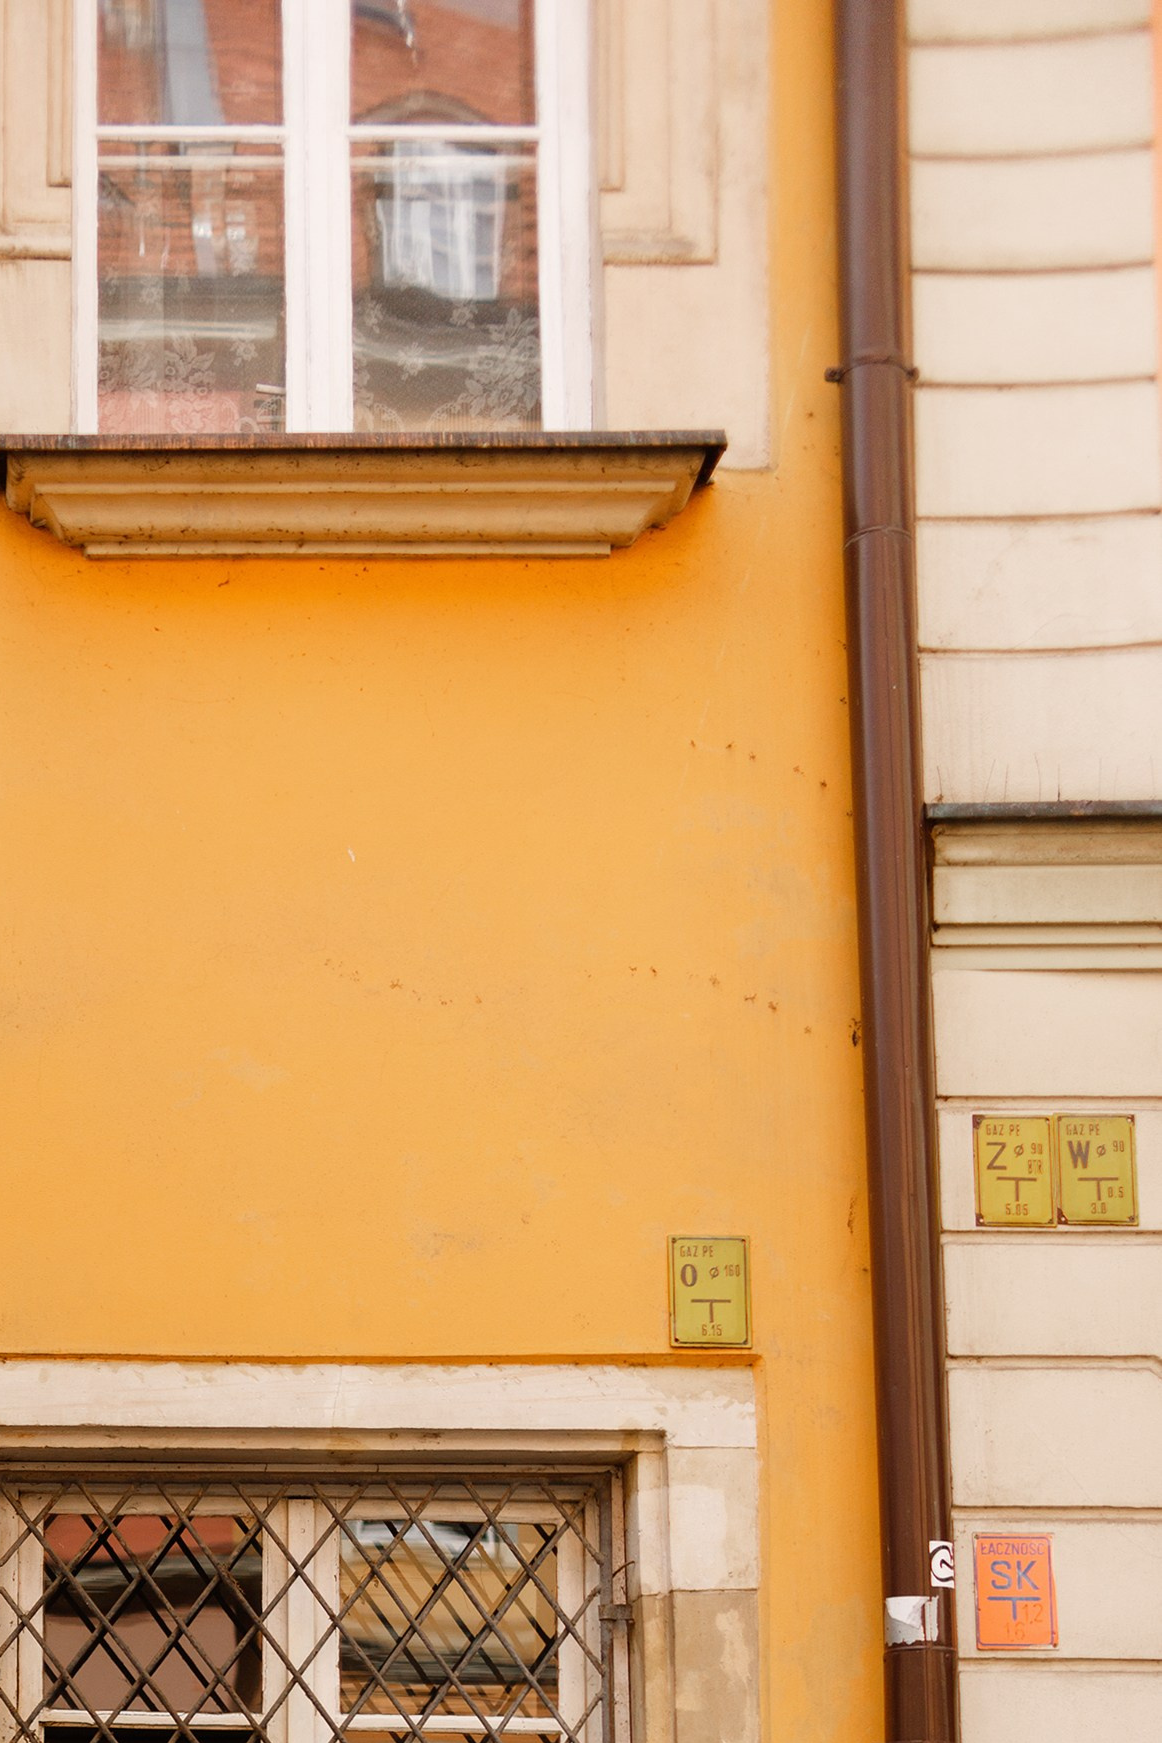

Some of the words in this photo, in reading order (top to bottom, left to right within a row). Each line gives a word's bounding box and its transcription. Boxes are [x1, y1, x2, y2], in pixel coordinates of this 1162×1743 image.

[985, 1123, 1004, 1136] GAZ
[1009, 1123, 1020, 1136] PE
[1066, 1123, 1084, 1136] GAZ
[1089, 1123, 1100, 1136] PE
[986, 1141, 1007, 1170] Z
[1067, 1140, 1090, 1169] W
[1113, 1140, 1125, 1152] 90
[1107, 1186, 1124, 1198] 0.5
[679, 1245, 698, 1257] GAZ
[702, 1245, 714, 1257] PE
[701, 1324, 723, 1337] 6.15
[990, 1560, 1039, 1590] SK
